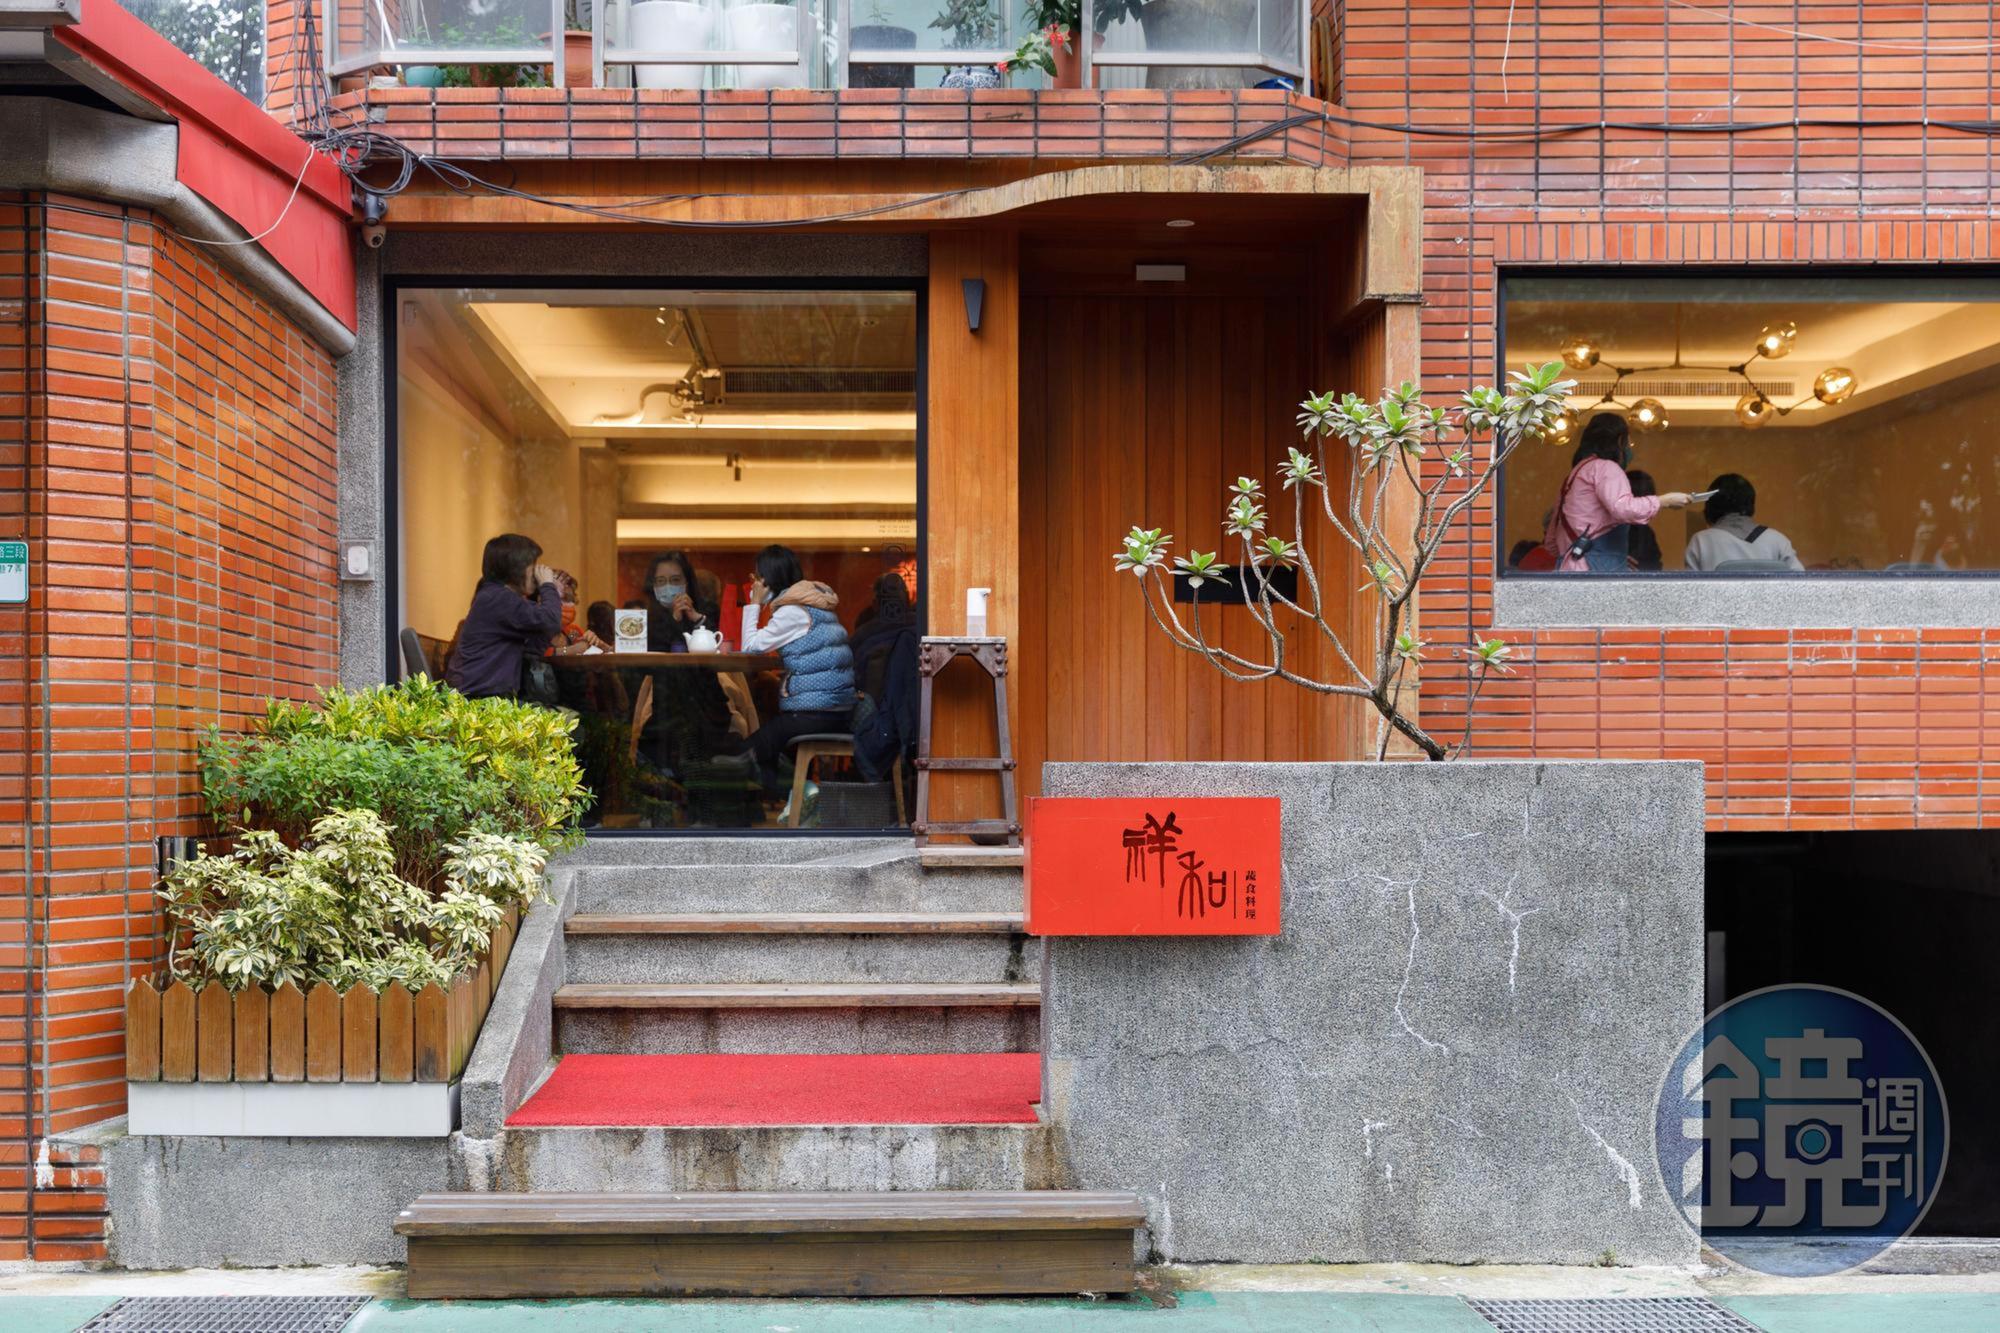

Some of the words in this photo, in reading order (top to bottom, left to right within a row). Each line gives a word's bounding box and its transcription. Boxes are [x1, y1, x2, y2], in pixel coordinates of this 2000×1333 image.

[1122, 811, 1227, 920] 祥和
[1245, 870, 1257, 920] 蔬食料理
